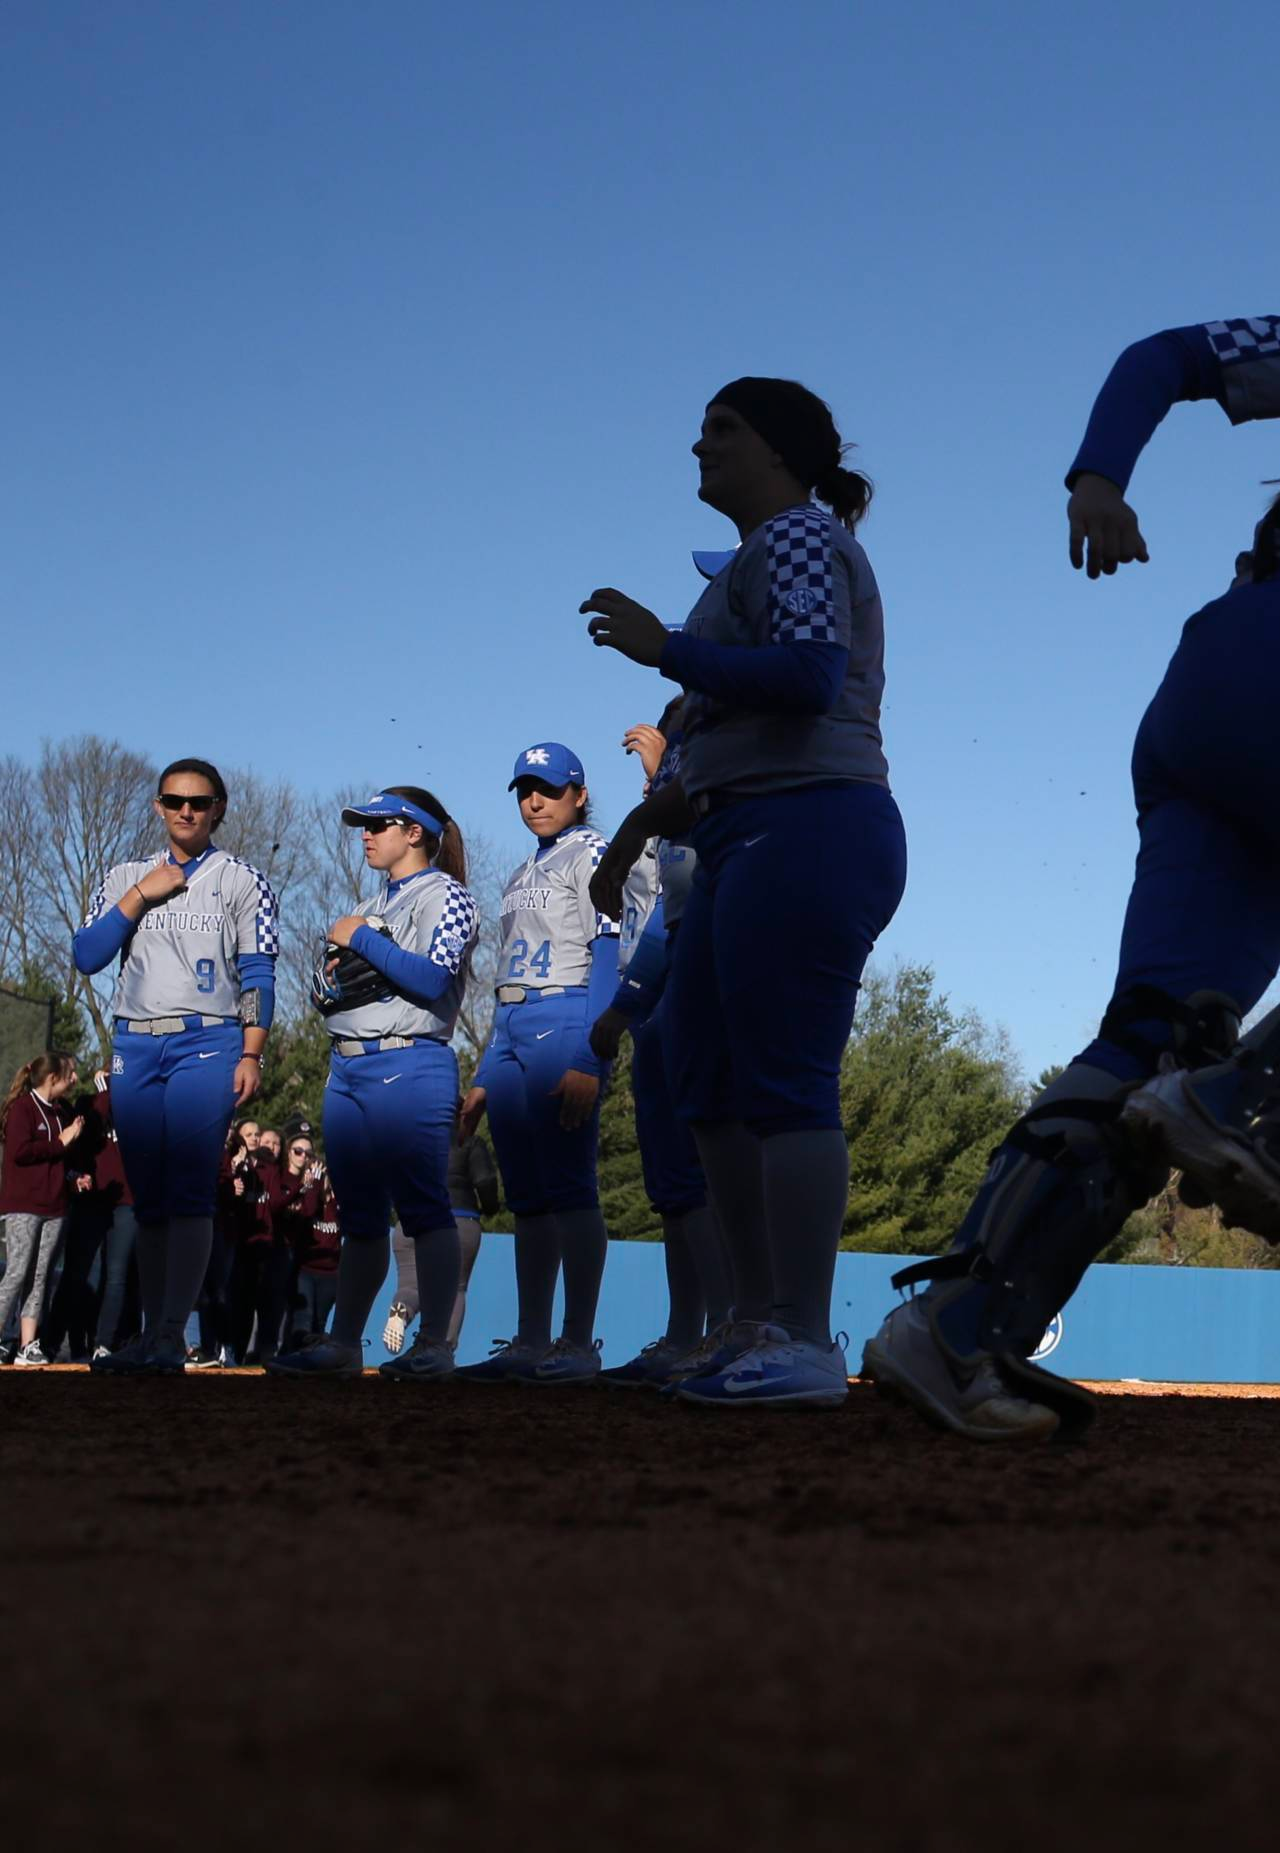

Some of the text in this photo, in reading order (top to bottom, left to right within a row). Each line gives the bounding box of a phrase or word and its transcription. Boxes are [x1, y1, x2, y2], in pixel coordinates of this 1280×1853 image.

[787, 590, 816, 613] SEC
[196, 958, 215, 993] 9
[508, 939, 552, 978] 24
